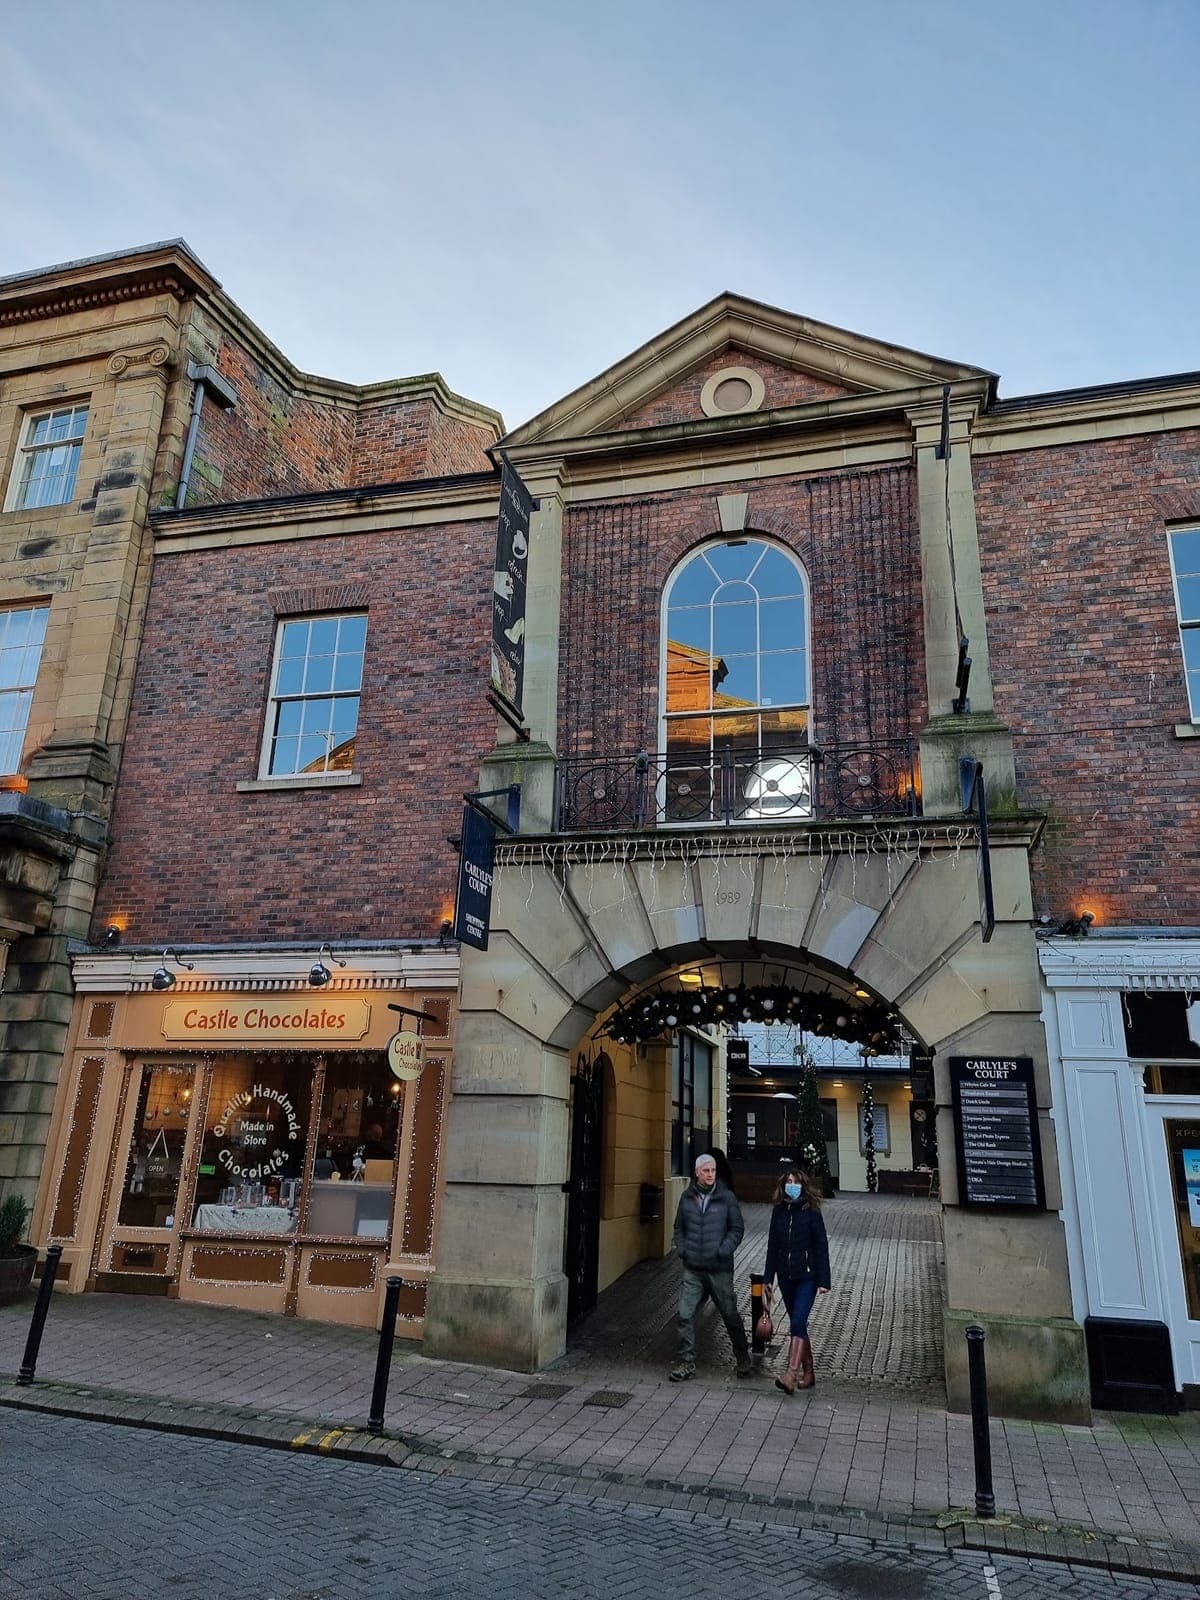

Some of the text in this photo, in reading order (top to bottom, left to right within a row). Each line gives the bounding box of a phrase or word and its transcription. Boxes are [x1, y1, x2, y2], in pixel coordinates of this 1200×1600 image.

[468, 876, 488, 897] COURT
[716, 891, 741, 905] 1989
[465, 912, 486, 931] SHOPPING
[467, 923, 483, 939] CENTRE
[183, 1008, 346, 1030] Castle Chocolates
[394, 1038, 415, 1057] Castle
[966, 1061, 1017, 1071] CARLYLE'S
[974, 1070, 1010, 1079] COURT
[213, 1083, 301, 1140] Quality Handmade
[240, 1121, 274, 1131] Made in
[244, 1134, 267, 1146] Store
[218, 1150, 289, 1178] Chocolates
